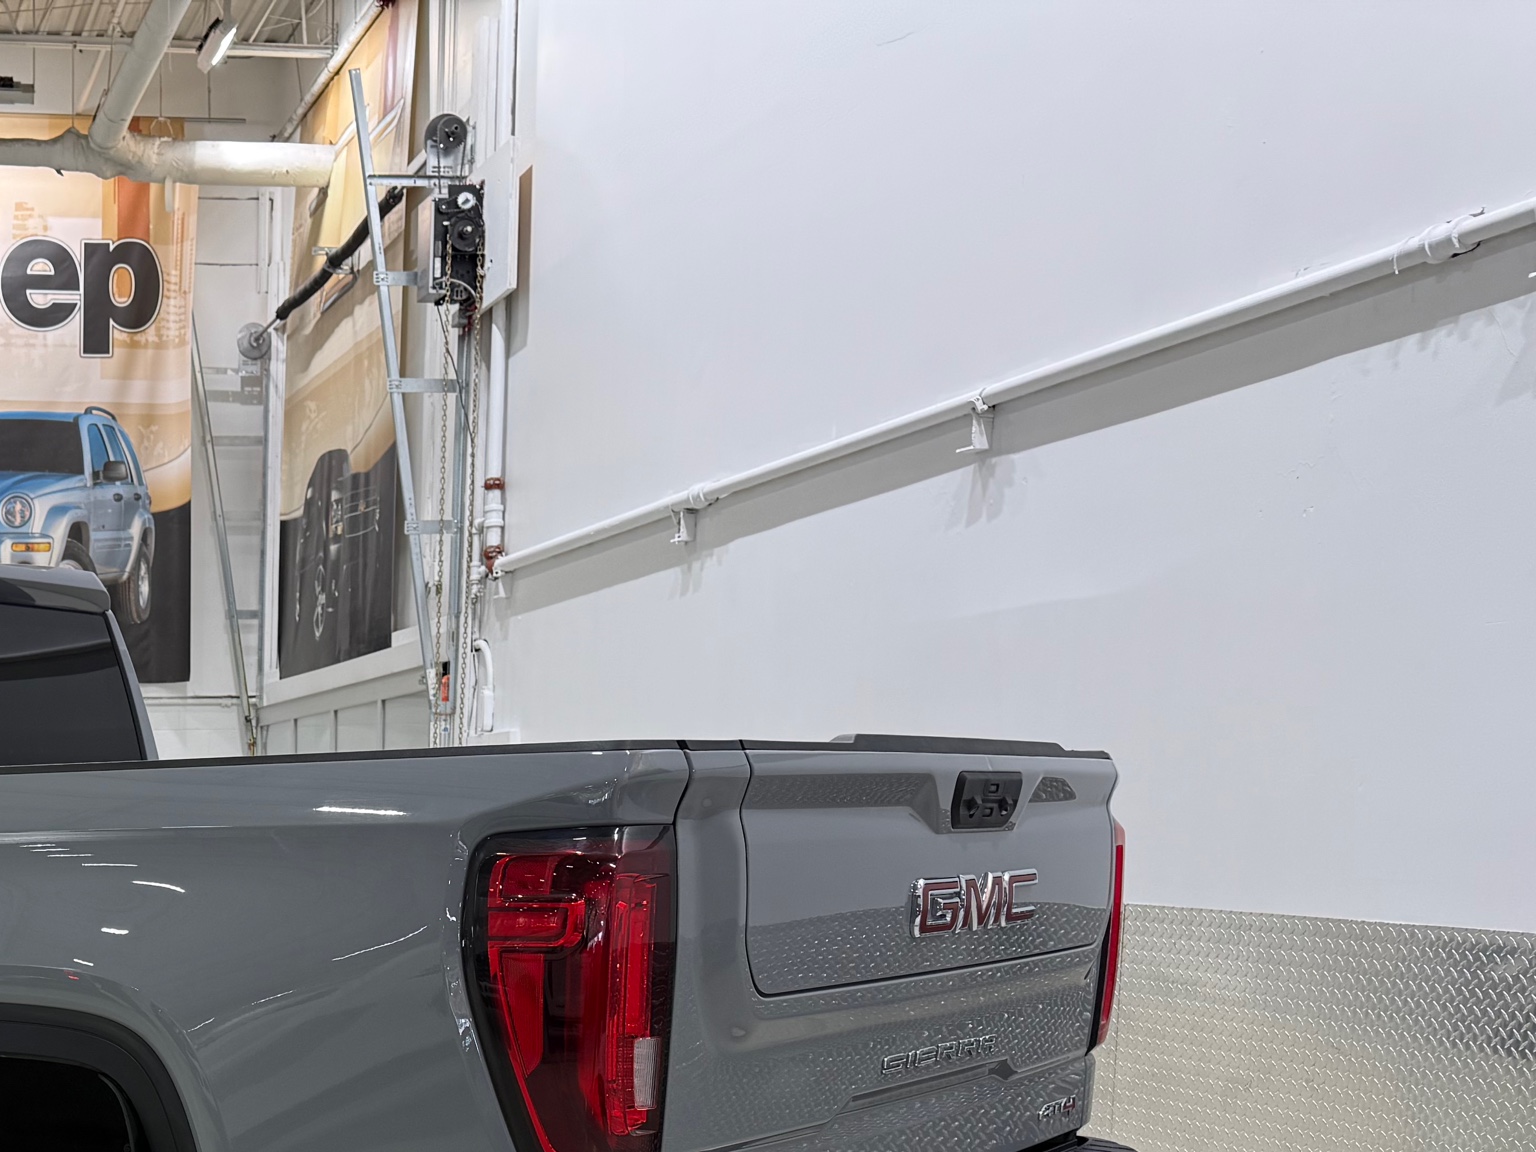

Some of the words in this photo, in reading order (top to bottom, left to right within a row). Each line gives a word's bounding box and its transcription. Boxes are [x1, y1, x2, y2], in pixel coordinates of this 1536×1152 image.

[909, 868, 1039, 938] GMC
[881, 1033, 998, 1075] SIERRA
[1037, 1094, 1077, 1120] AT4
